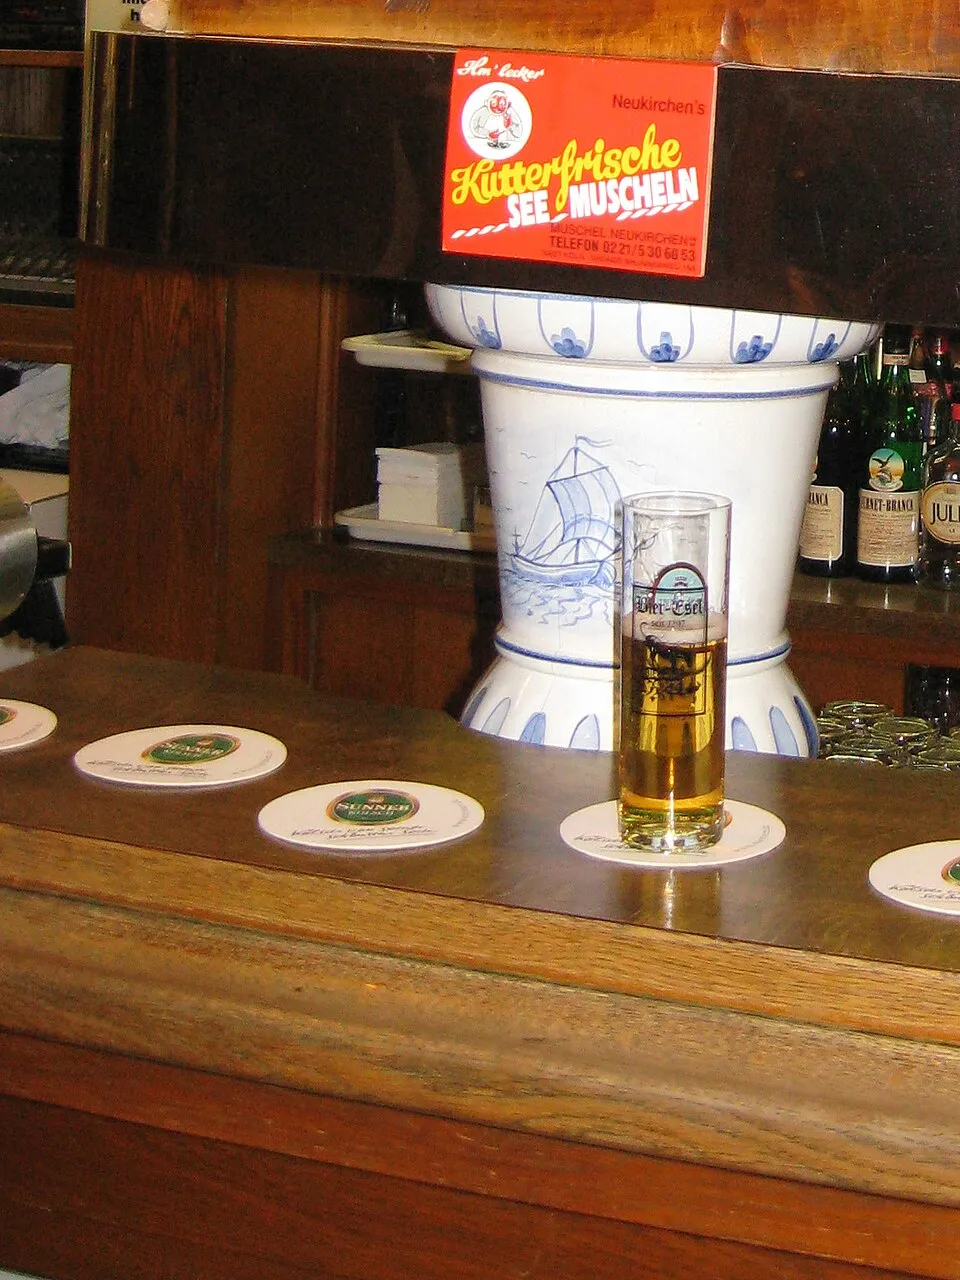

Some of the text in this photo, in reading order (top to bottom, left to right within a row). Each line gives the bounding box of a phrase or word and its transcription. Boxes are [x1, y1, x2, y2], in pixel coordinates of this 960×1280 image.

[498, 63, 545, 82] lecker
[612, 94, 706, 116] Neukirchen's
[451, 123, 682, 212] Kutterfrische
[507, 167, 699, 228] SEE MUSCHELN
[551, 222, 605, 238] MUSCHEL
[551, 235, 599, 252] TELEFON
